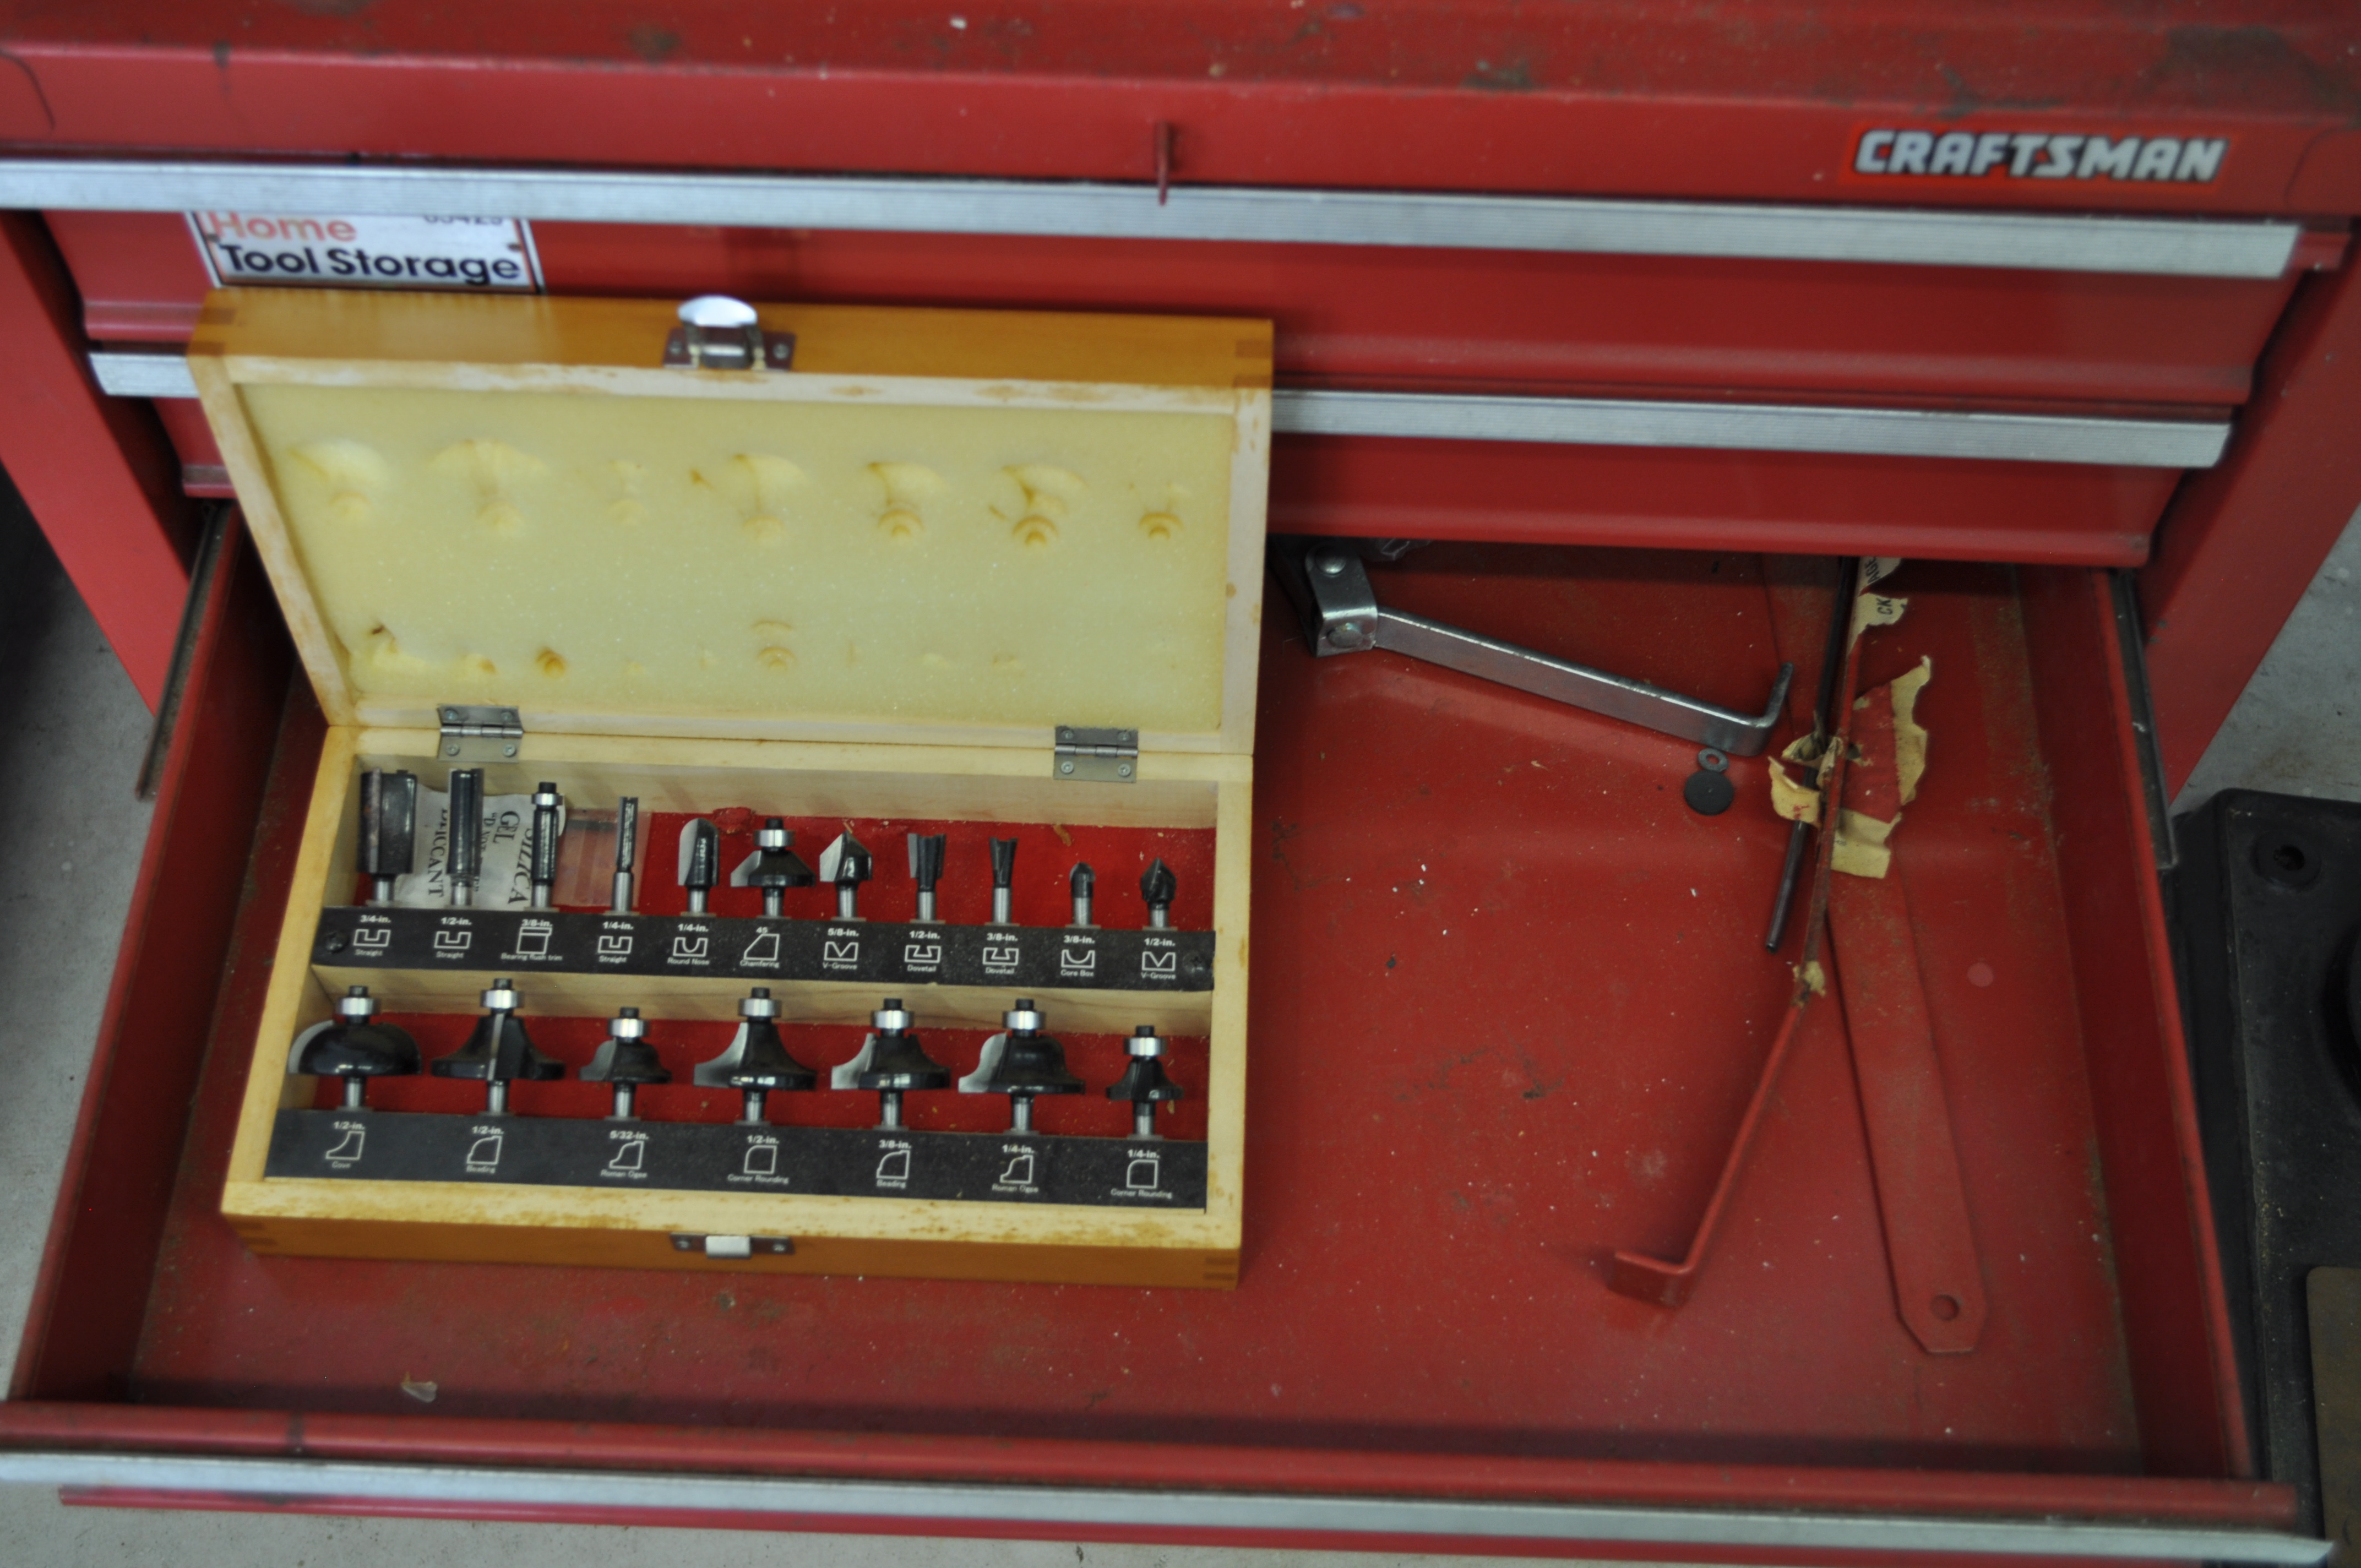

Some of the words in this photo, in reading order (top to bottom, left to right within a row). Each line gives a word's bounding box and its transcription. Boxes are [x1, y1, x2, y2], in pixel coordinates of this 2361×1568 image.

[1854, 129, 2229, 182] CRAFTSMAN
[211, 213, 357, 242] Home
[220, 244, 320, 274] Tool
[327, 248, 520, 286] Storage
[360, 914, 391, 923] 3/4-in.
[441, 917, 472, 926] 1/2-in.
[521, 919, 553, 927] 3/8-in.
[602, 922, 634, 930] 1/4-in.
[678, 924, 709, 932] 1/4-in.
[828, 928, 859, 937] 5/8-in.
[909, 930, 941, 939] 1/2-in.
[987, 933, 1018, 941] 3/8-in.
[1064, 935, 1095, 944] 3/8-in.
[1144, 938, 1176, 946] 1/2-in.
[333, 1121, 366, 1130] 1/2-in.
[472, 1125, 504, 1135] 1/2-in.
[610, 1130, 650, 1140] 5/32-in.
[747, 1135, 780, 1144] 1/2-in.
[879, 1140, 911, 1149] 3/8-in.
[1002, 1144, 1035, 1153] 1/4-in.
[1127, 1148, 1160, 1158] 1/4-in.
